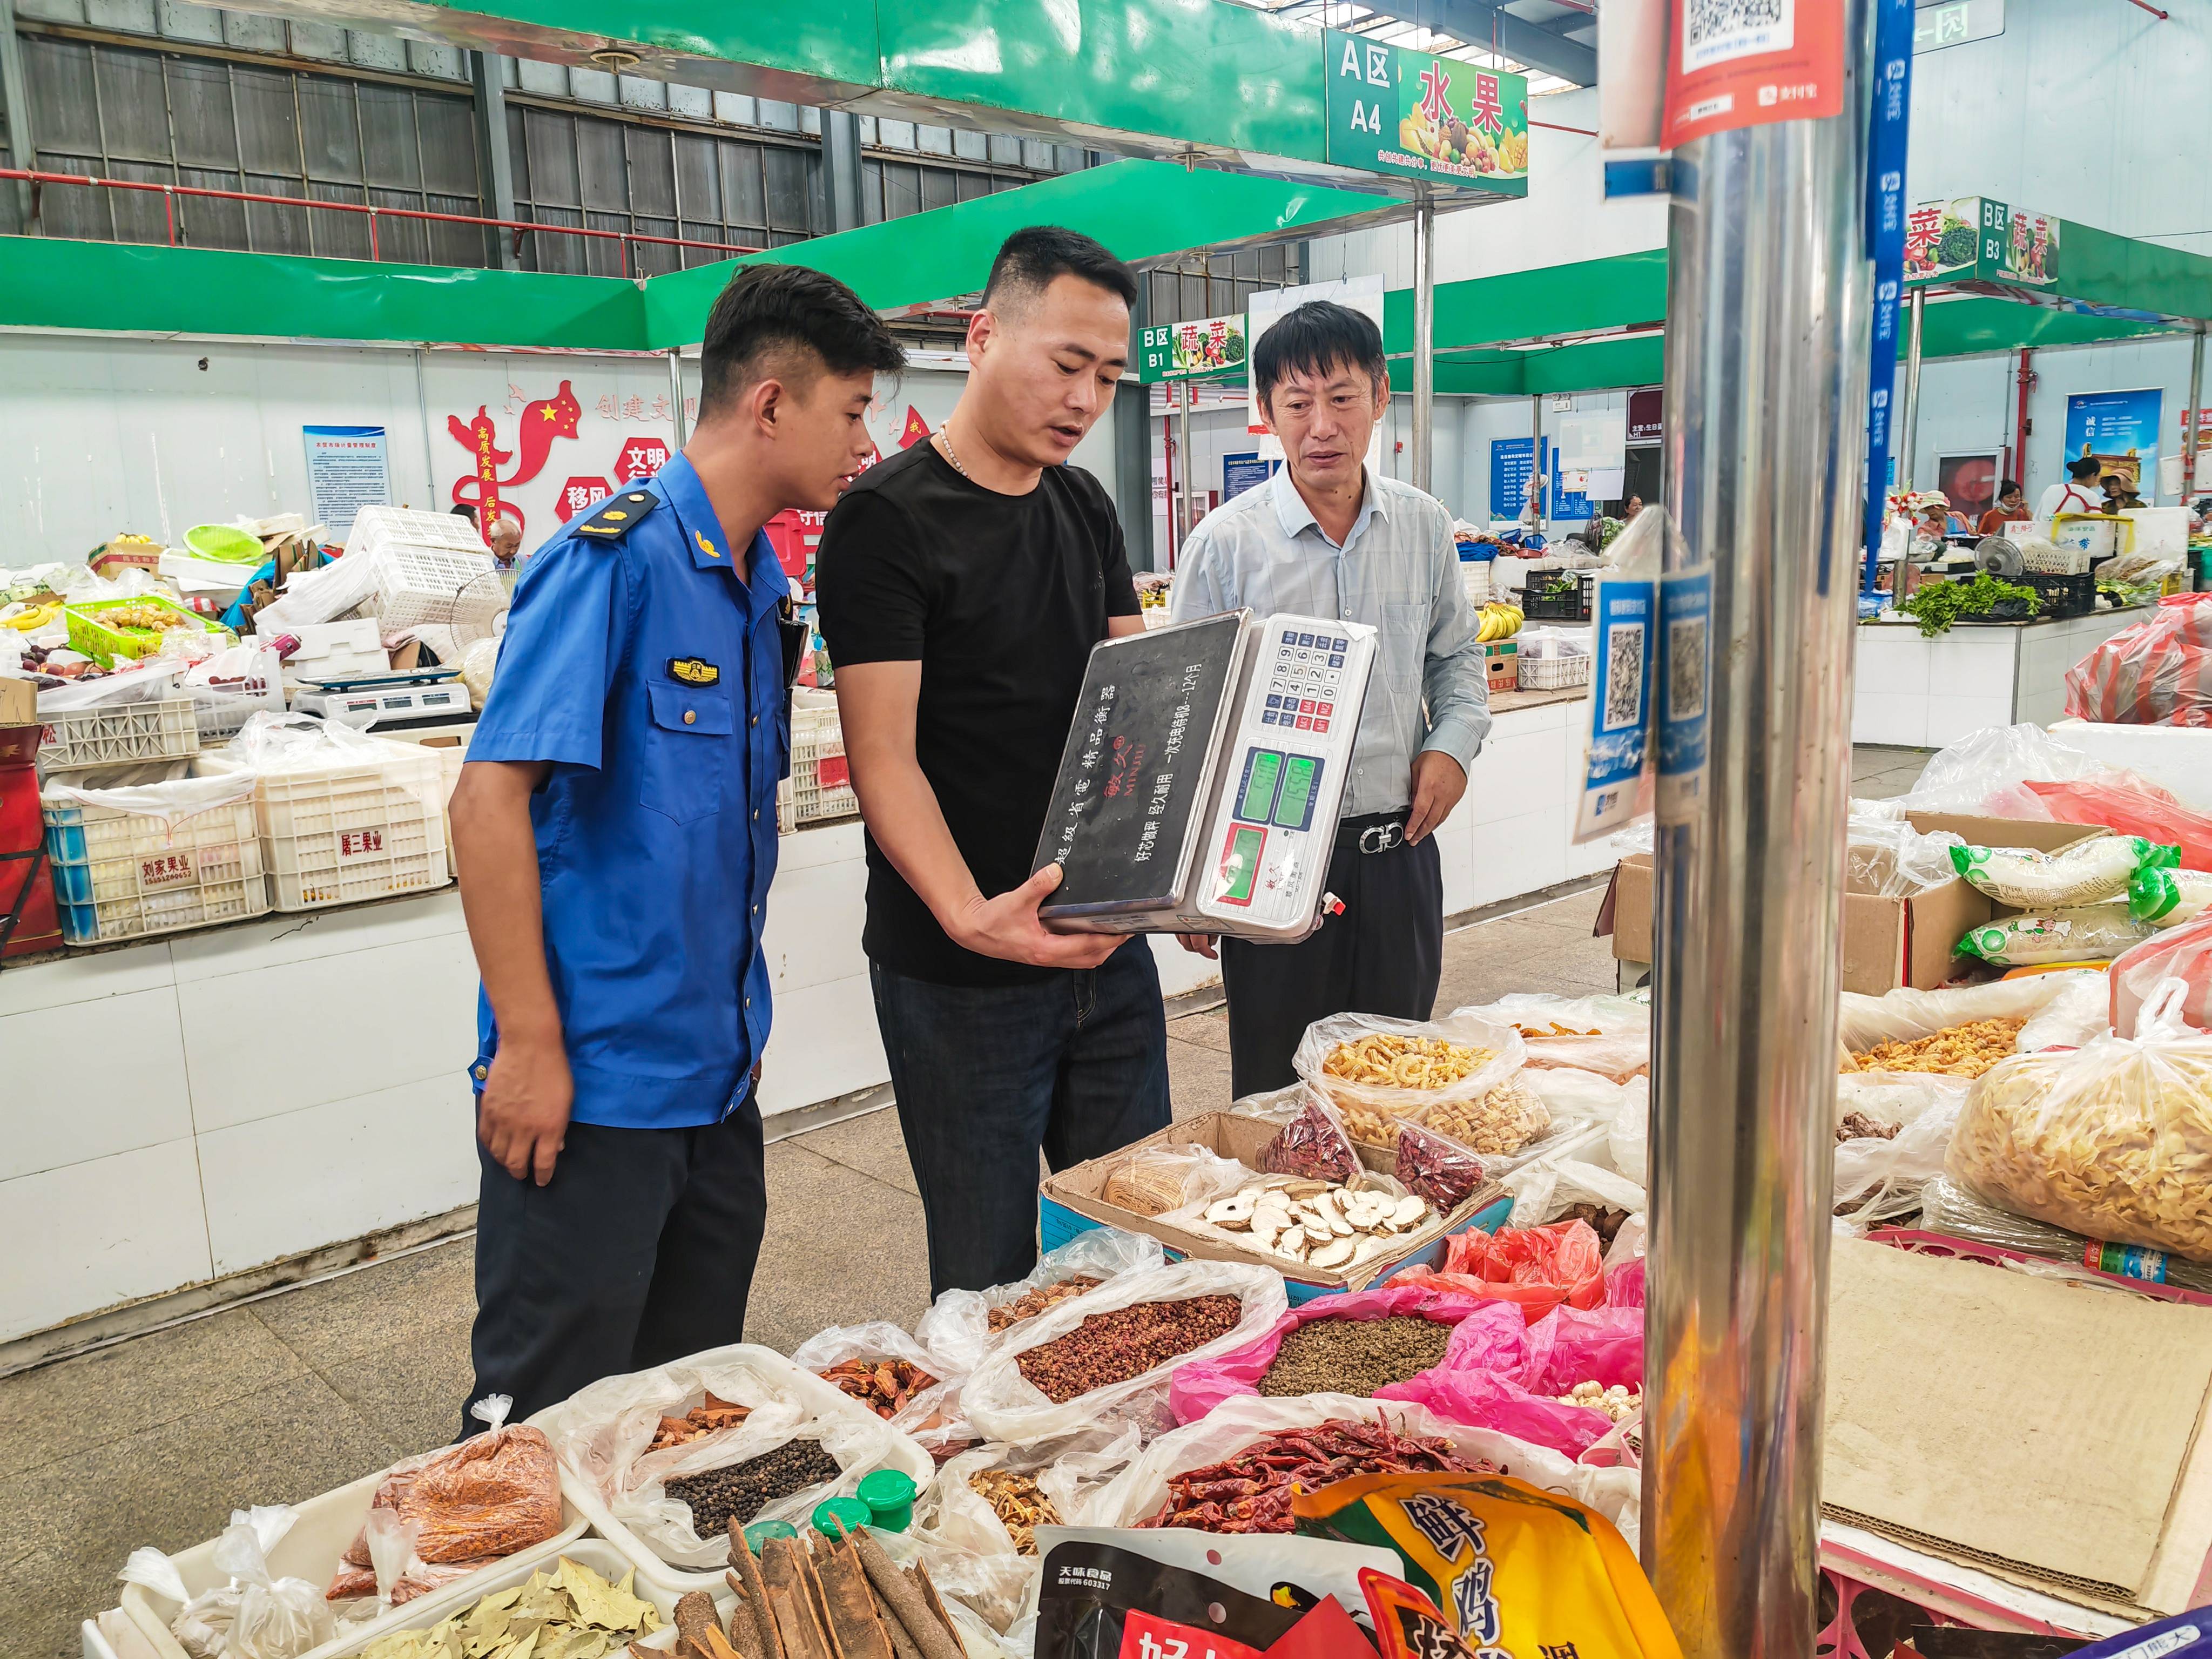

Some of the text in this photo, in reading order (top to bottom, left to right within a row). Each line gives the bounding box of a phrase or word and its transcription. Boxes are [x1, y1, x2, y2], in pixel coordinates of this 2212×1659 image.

[1340, 39, 1390, 88] A区
[1420, 60, 1502, 135] 水果
[1351, 99, 1381, 134] A4
[1984, 202, 2005, 231] B区
[2014, 212, 2048, 255] 蔬菜
[1986, 239, 2000, 260] B3
[1144, 328, 1168, 347] B区
[1182, 321, 1226, 351] 蔬菜
[1149, 353, 1163, 367] B1
[627, 447, 666, 470] 文明
[567, 486, 605, 509] 移风
[1321, 704, 1330, 714] M2
[1317, 720, 1326, 730] M1
[142, 855, 190, 878] 刘家果业
[1058, 1577, 1110, 1590] 股票代码 603317
[1059, 1566, 1112, 1582] 天味食品
[1400, 1493, 1515, 1659] 鲜鸡
